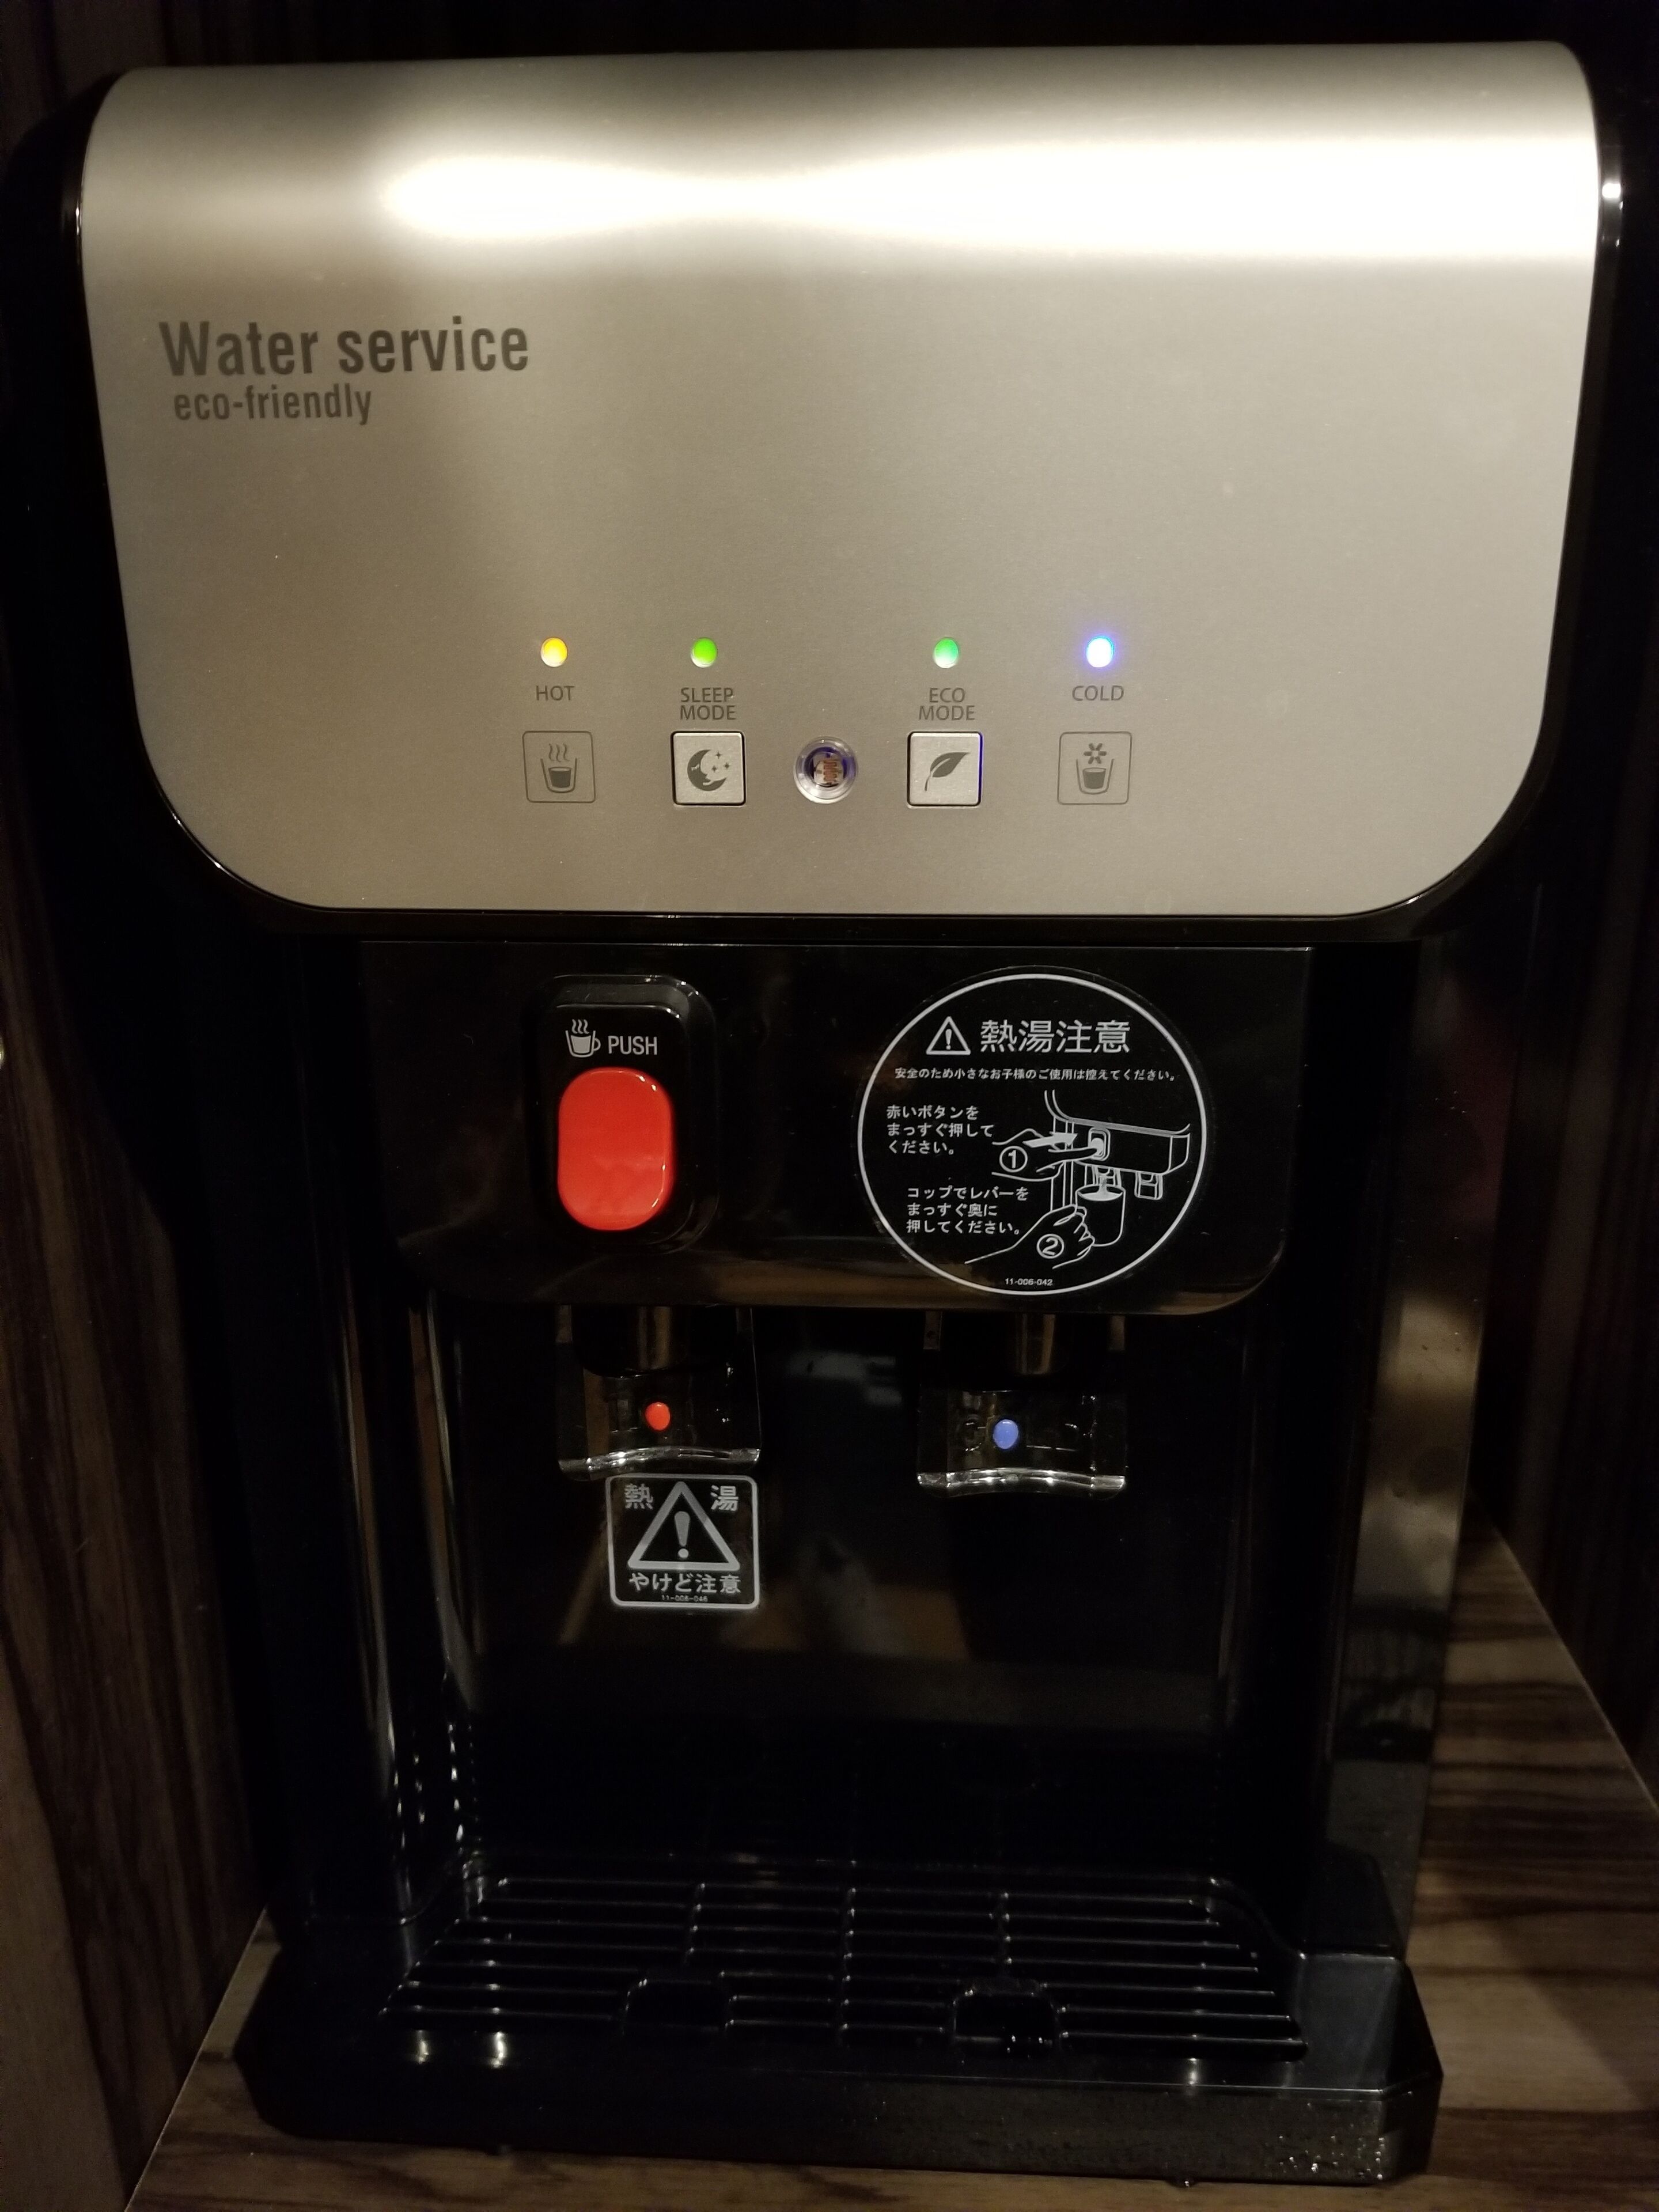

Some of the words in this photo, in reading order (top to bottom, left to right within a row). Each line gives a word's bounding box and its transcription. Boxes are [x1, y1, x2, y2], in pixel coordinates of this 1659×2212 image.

[159, 321, 319, 376] Water
[336, 315, 529, 373] service
[174, 383, 372, 425] eco-friendly
[535, 685, 574, 701] HOT
[680, 687, 734, 703] SLEEP
[929, 687, 965, 704] ECO
[1071, 685, 1125, 702] COLD
[679, 705, 737, 721] MODE
[918, 705, 976, 721] MODE
[980, 1020, 1131, 1053] 熱湯注意
[608, 1035, 658, 1055] PUSH
[894, 1067, 1177, 1081] 安全のため小さなお子様のご使用は控えてください。
[886, 1105, 979, 1120] 赤いボタンを
[888, 1122, 994, 1138] まっすぐ押して
[889, 1140, 956, 1155] ください。
[907, 1187, 1029, 1202] コップでレバーを
[907, 1203, 998, 1218] まっすぐ奥に
[906, 1220, 1021, 1236] 押してください。
[1005, 1278, 1054, 1287] 11-006-042
[624, 1483, 653, 1510] 熱
[710, 1484, 739, 1512] 湯
[629, 1572, 741, 1594] やけど注意
